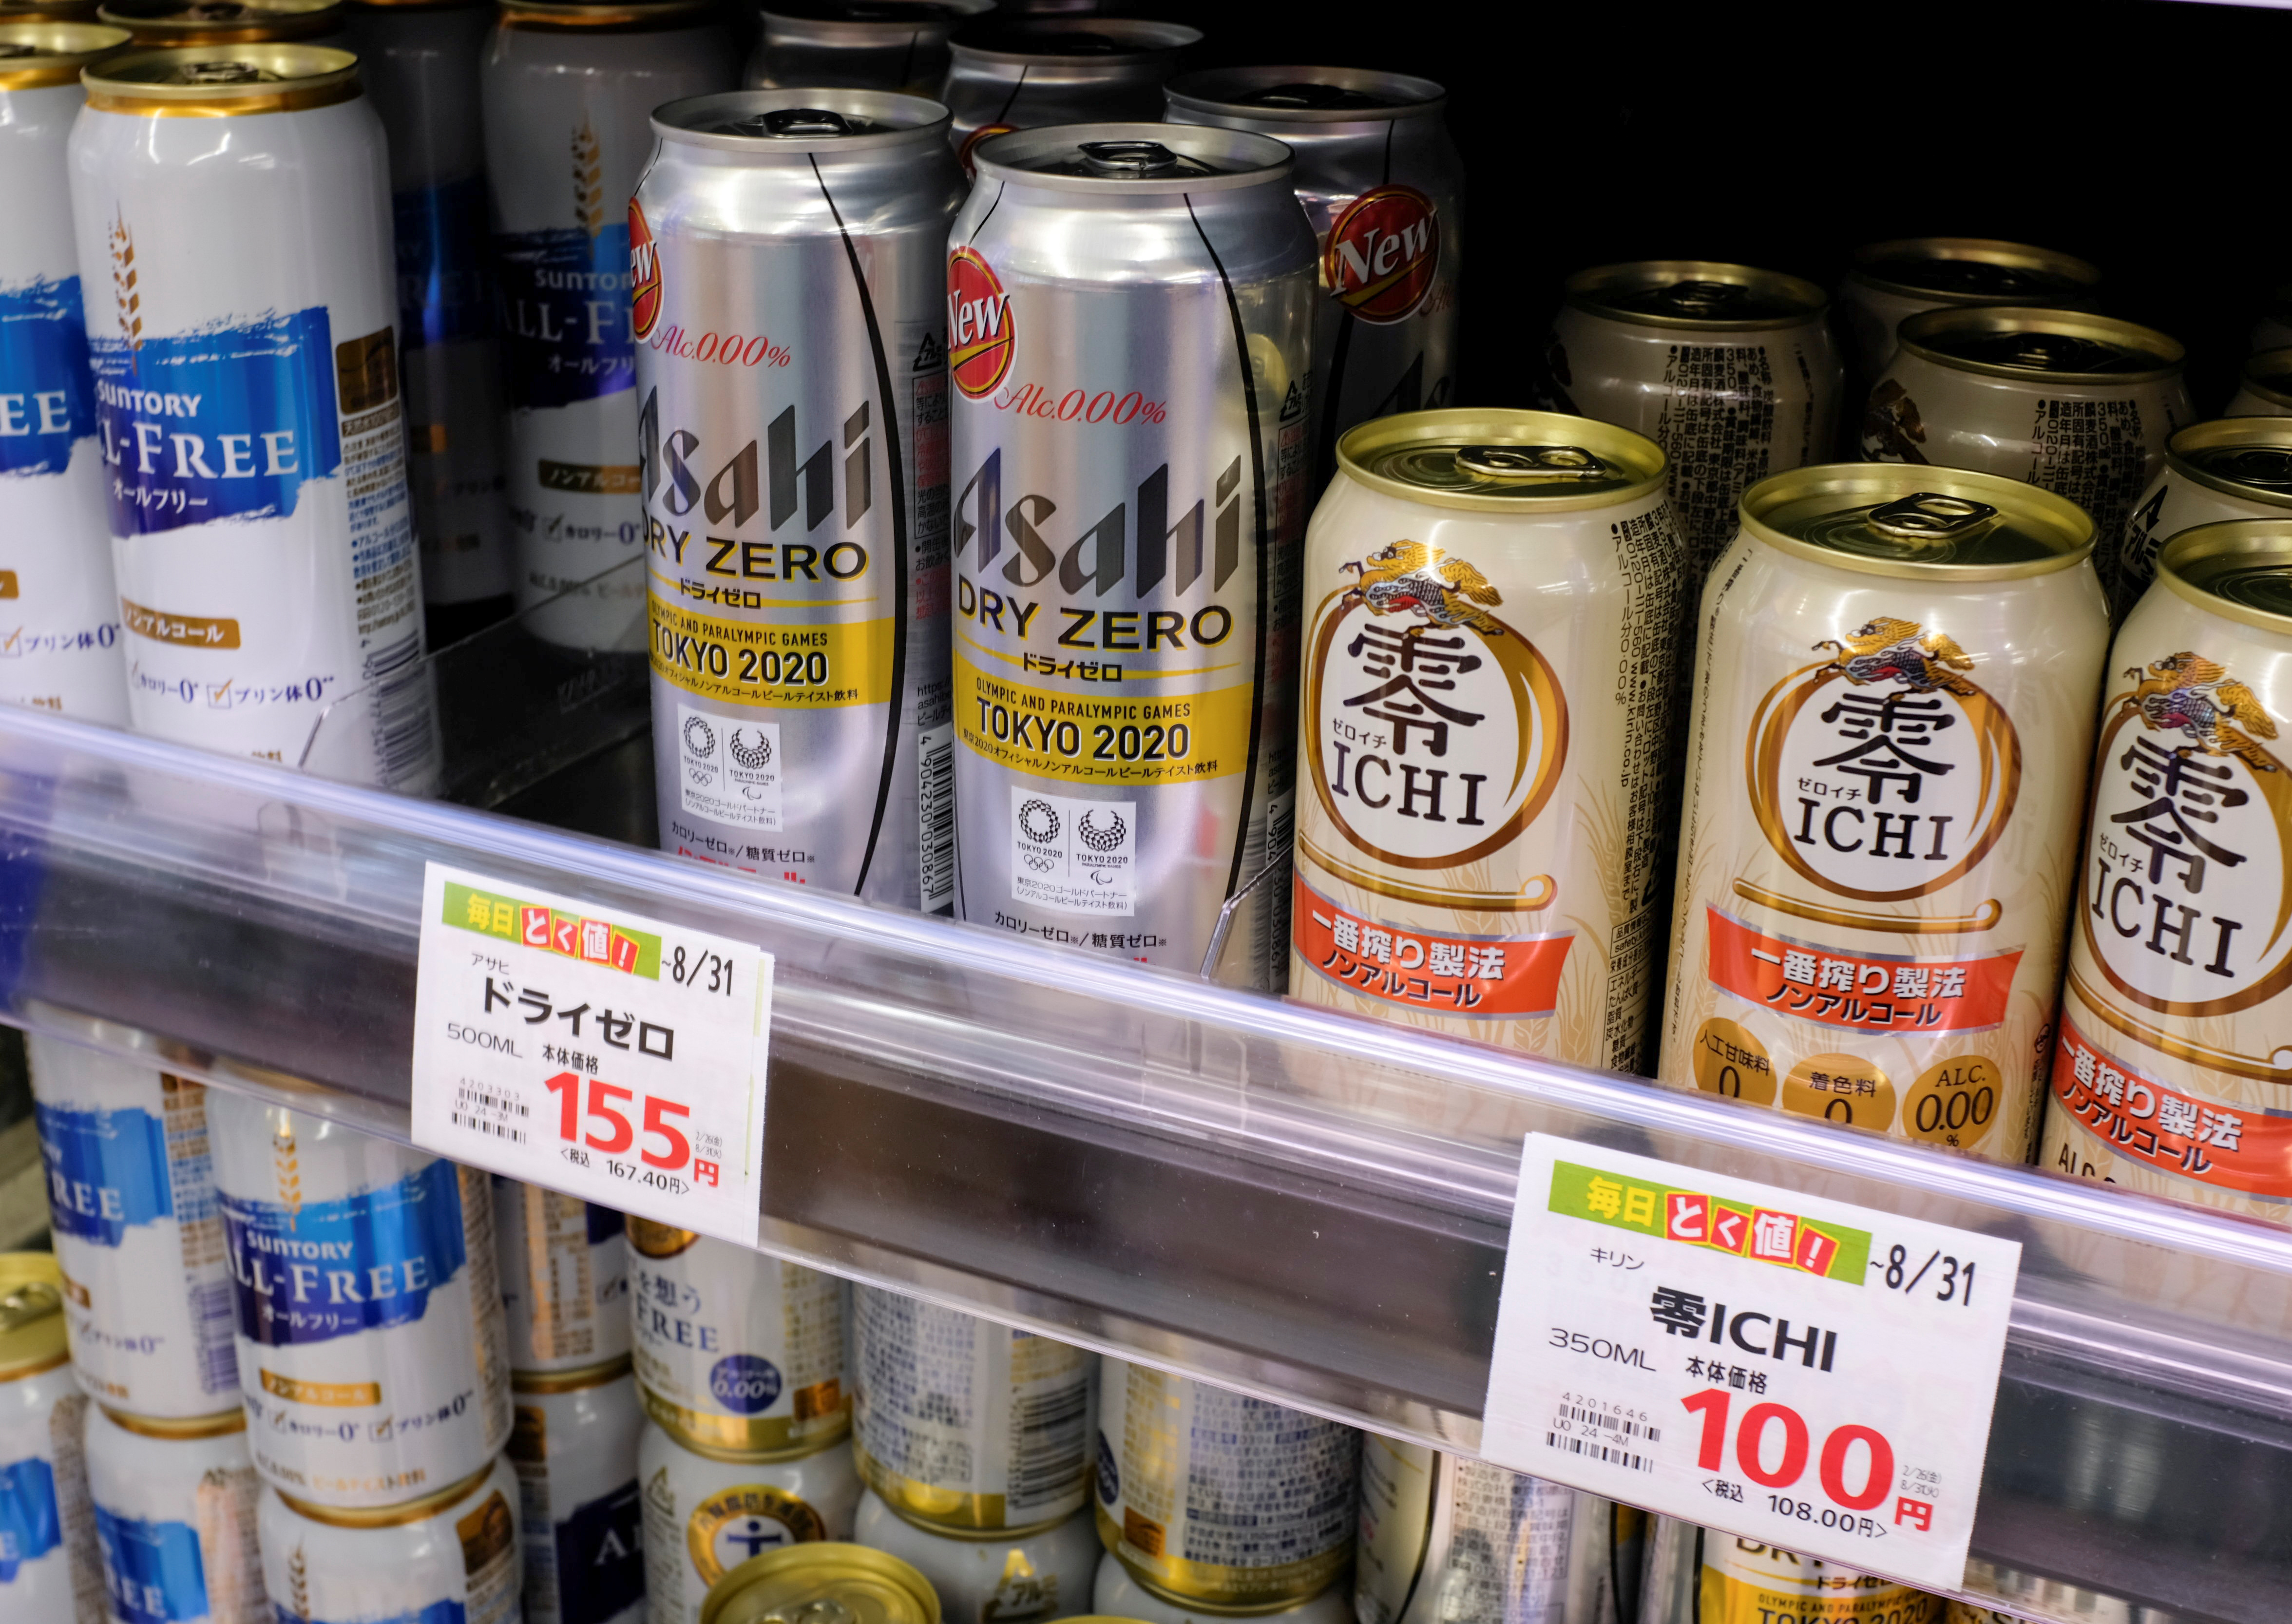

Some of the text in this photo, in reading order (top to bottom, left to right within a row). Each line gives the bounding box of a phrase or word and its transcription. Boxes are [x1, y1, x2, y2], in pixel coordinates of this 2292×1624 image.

[631, 240, 657, 286] ew
[1330, 207, 1436, 295] New
[948, 289, 1010, 349] New
[994, 383, 1166, 425] Alc.0.00%
[100, 417, 299, 480] L-FREE
[639, 385, 871, 531] Asahi
[113, 478, 209, 514] オールフリー
[953, 447, 1241, 599] Asahi
[706, 536, 869, 582] ZERO
[680, 577, 761, 609] ドライゼロ
[959, 573, 1041, 641] DRY
[1058, 605, 1234, 652] ZERO
[652, 600, 828, 647] OLYMPIC AND PARALYMPIC GAMES
[653, 618, 829, 686] TOKYO 2020
[1023, 652, 1122, 682] ドライゼロ
[976, 677, 1191, 720] OLYMPIC AND PARALYMPIC GAMES
[1343, 624, 1485, 756] 零
[977, 696, 1190, 762] TOKYO 2020
[1332, 717, 1387, 748] ゼロイチ
[1813, 692, 1955, 804] 零
[703, 763, 718, 773] 2020
[729, 769, 753, 780] TOKYO
[1332, 740, 1487, 825] ICHI
[1797, 777, 1862, 801] ゼロイチ
[1794, 797, 1953, 860] ICHI
[2110, 735, 2249, 894] 零
[1017, 841, 1063, 859] TOKYO 2020
[1076, 854, 1105, 863] TOKYO
[2100, 832, 2144, 873] ゼロイチ
[1017, 876, 1127, 898] 東京2020ゴールドパートナー
[2092, 856, 2242, 978] ICHI
[472, 953, 510, 975] アサヒ
[1312, 909, 1506, 980] 一番搾り製法
[1322, 950, 1483, 1009] ノンアルコール
[1751, 948, 1967, 1000] 一番搾り製法
[484, 976, 674, 1061] ドライゼロ
[1766, 984, 1944, 1027] ノンアルコール
[447, 1023, 523, 1058] 500ML
[542, 1043, 599, 1074] 本体価格
[1700, 1029, 1771, 1077] 人工甘味料
[1809, 1072, 1876, 1097] 着色料
[1935, 1065, 1986, 1089] ALC.
[2062, 1034, 2244, 1152] 一番搾り製法
[544, 1071, 719, 1188] 155 円
[1916, 1086, 1994, 1133] 0.00
[2063, 1080, 2213, 1175] ノンアルコール
[236, 1249, 429, 1305] LL-FREE
[1591, 1247, 1645, 1271] キリン
[1548, 1328, 1658, 1372] 350ML
[1649, 1285, 1839, 1374] 零ICHI
[1685, 1356, 1768, 1395] 本体価格
[1562, 1392, 1647, 1422] 4201646
[1581, 1425, 1598, 1438] 24
[1680, 1388, 1934, 1532] 100 円
